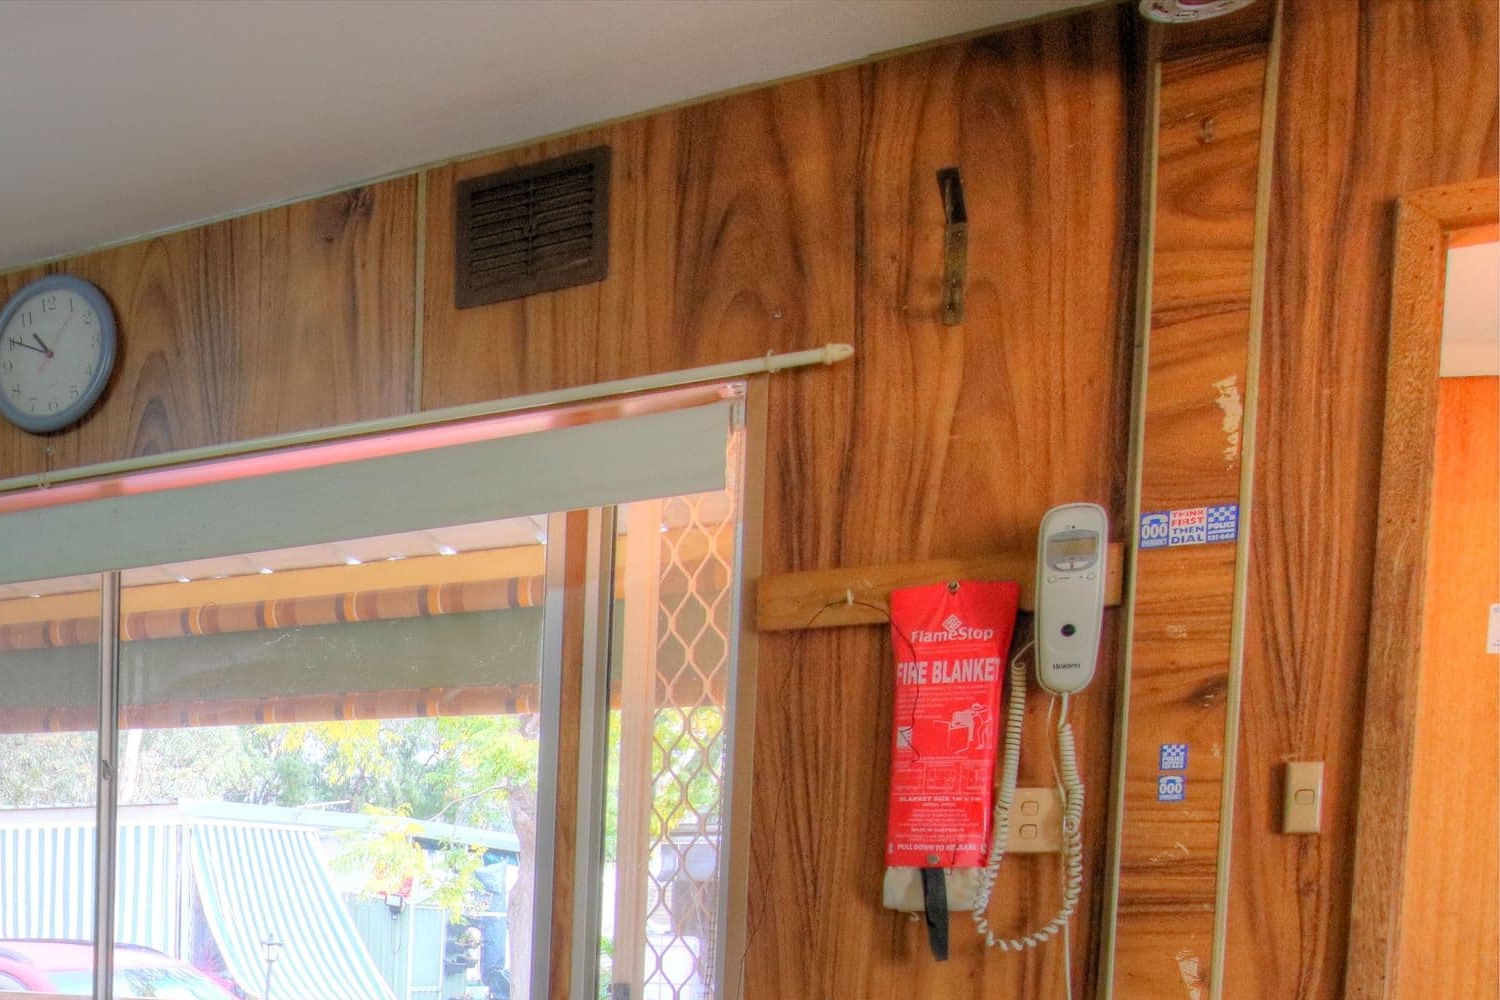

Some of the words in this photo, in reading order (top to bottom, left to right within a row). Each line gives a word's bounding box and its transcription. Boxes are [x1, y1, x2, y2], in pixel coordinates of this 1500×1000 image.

[42, 296, 56, 312] 12
[21, 311, 32, 327] 11
[83, 310, 92, 325] 2
[3, 360, 13, 376] 9
[30, 397, 37, 413] 7
[1172, 510, 1204, 518] THINK
[1171, 517, 1204, 527] FIRST
[1208, 521, 1236, 529] POLICE
[1141, 523, 1168, 539] 000
[1172, 525, 1205, 535] THEN
[1171, 534, 1205, 544] DIAL
[910, 627, 994, 643] FlameStop
[897, 661, 928, 685] FIRE
[931, 657, 1000, 684] BLANKET
[1159, 783, 1183, 794] 000
[914, 843, 934, 851] DOWN
